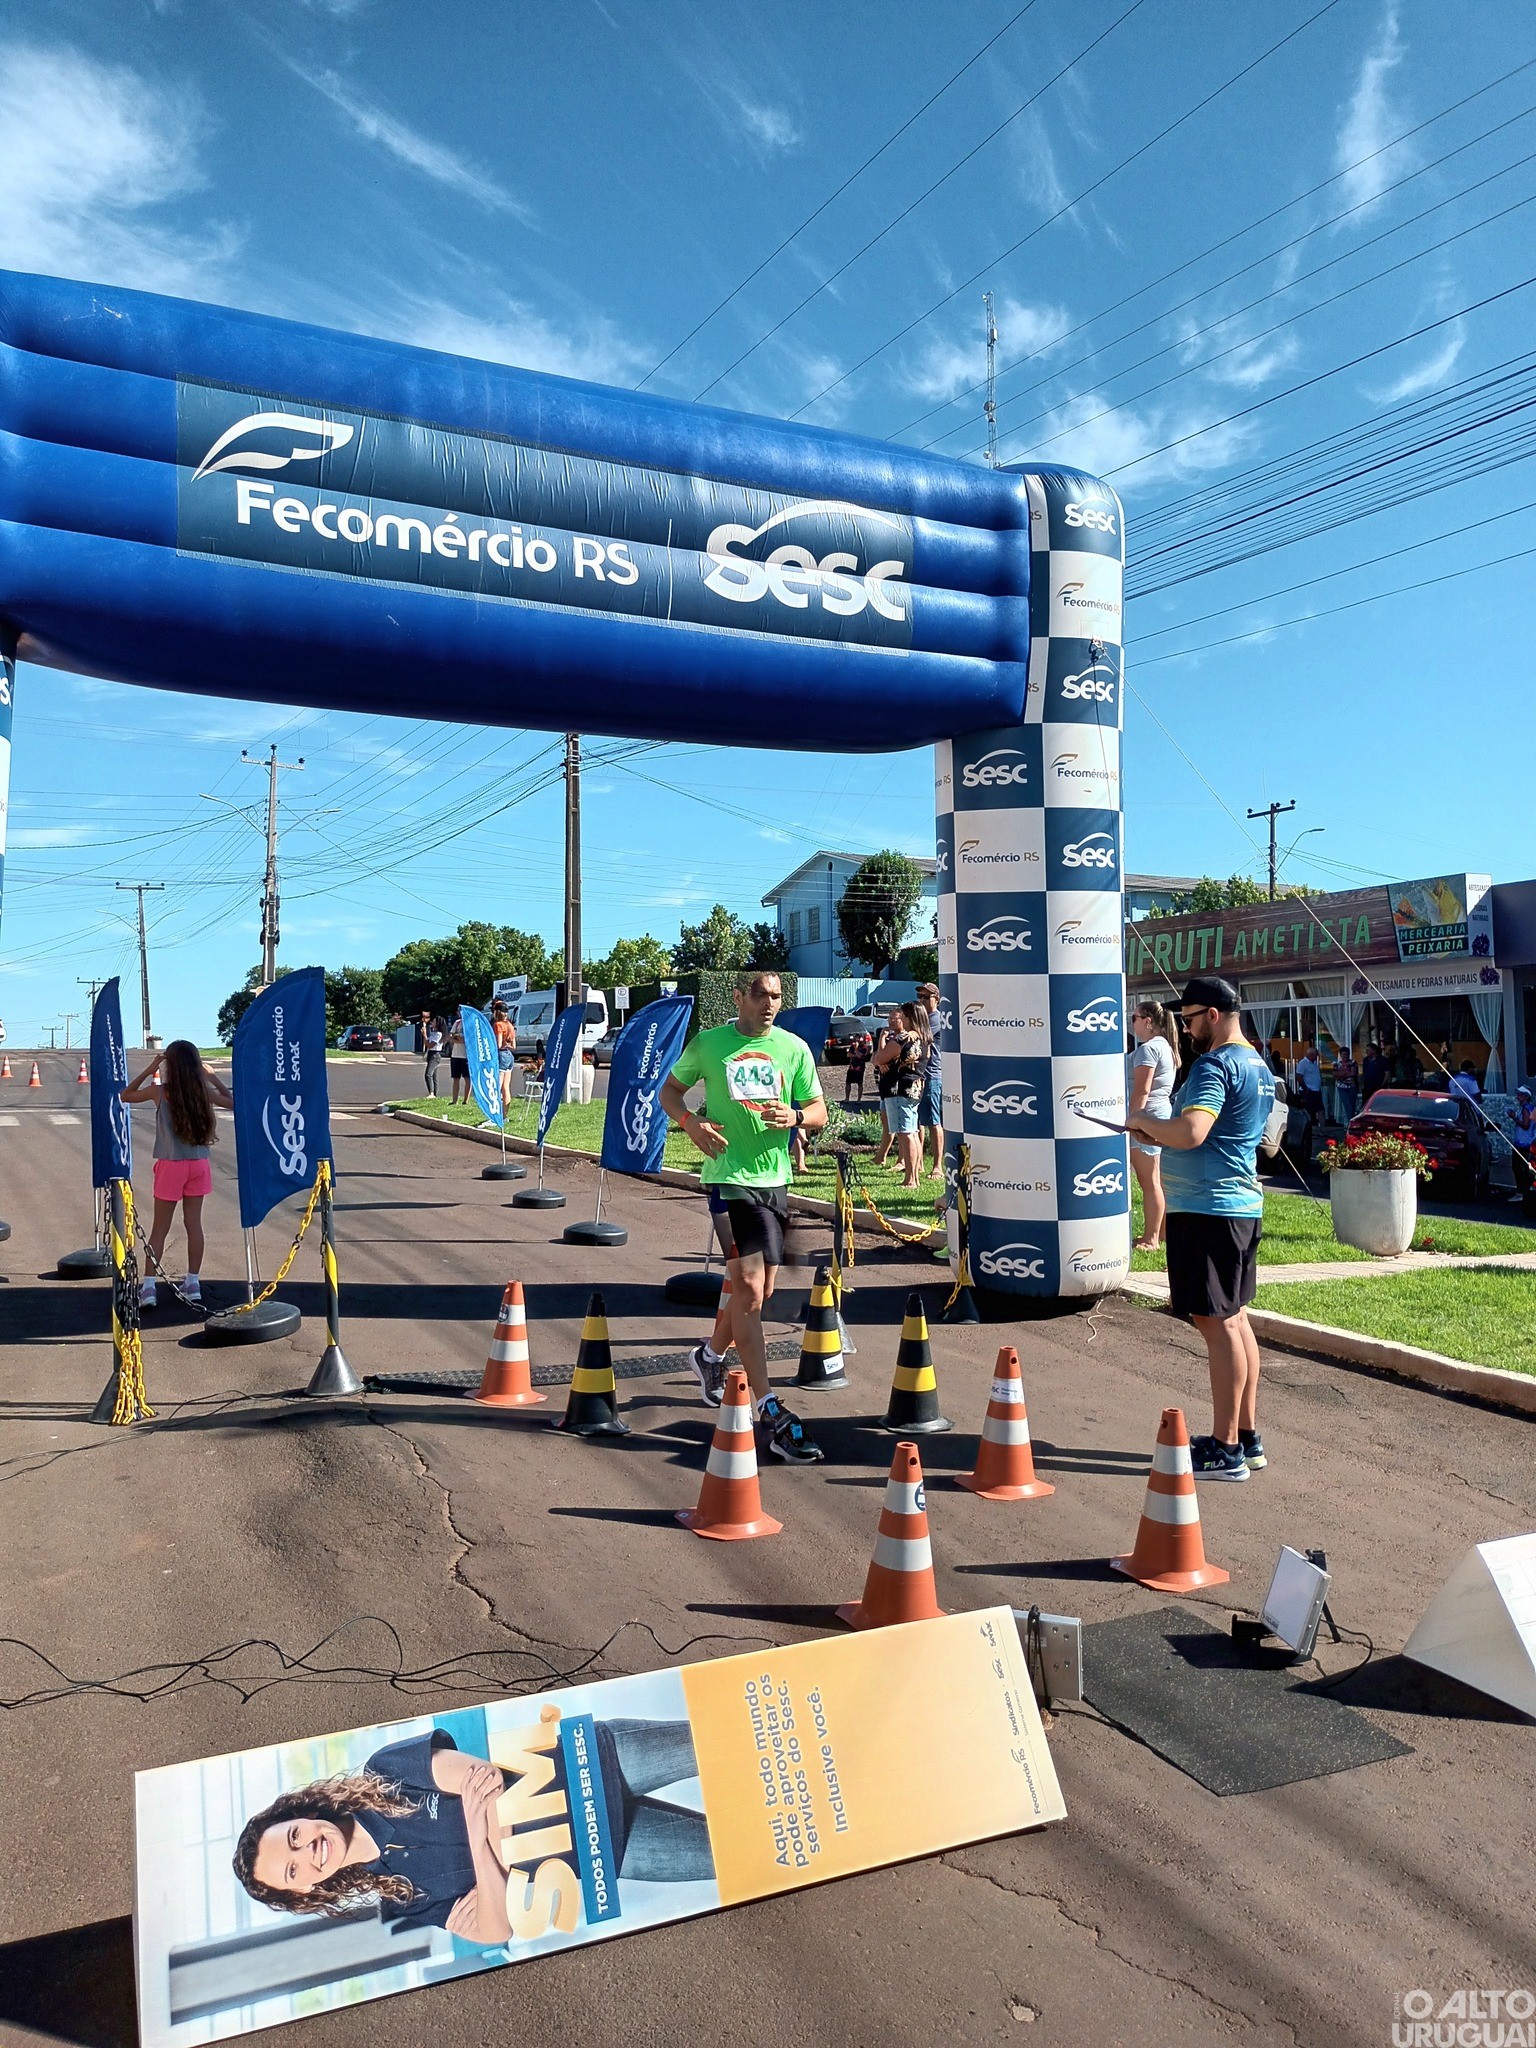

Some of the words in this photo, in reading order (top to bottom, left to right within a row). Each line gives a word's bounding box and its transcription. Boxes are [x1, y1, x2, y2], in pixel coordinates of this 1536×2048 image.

[236, 478, 558, 573] Fecomércio
[574, 534, 640, 586] RS
[1064, 495, 1116, 536] Sesc
[704, 499, 906, 621] Sesc
[1063, 596, 1113, 612] Fecomércio
[1113, 604, 1121, 615] RS
[1061, 665, 1115, 704] Sesc
[962, 748, 1028, 787] Sesc
[1057, 767, 1109, 779] Fecomércio
[1109, 770, 1118, 781] RS
[962, 852, 1021, 864] Fecomércio
[1023, 851, 1040, 862] RS
[1061, 832, 1115, 869] Sesc
[966, 915, 1032, 952] Sesc
[1061, 934, 1112, 945] Fecomércio
[1112, 934, 1120, 944] RS
[1125, 926, 1224, 976] IFRUTI
[1233, 914, 1371, 957] AMETISTA
[1400, 924, 1466, 940] MERCEARIA
[1408, 939, 1463, 954] PEIXARIA
[1371, 978, 1411, 990] ARTESANATO
[1412, 978, 1416, 988] E
[1417, 976, 1443, 988] PEDRAS
[1444, 973, 1478, 986] NATURAIS
[966, 1016, 1026, 1028] Fecomércio
[1028, 1017, 1045, 1028] RS
[1066, 996, 1119, 1033] Sesc
[272, 1005, 286, 1081] Fecomércio
[288, 1040, 301, 1081] Senac
[638, 1022, 658, 1079] Fecomércio
[650, 1049, 664, 1080] Senac
[734, 1065, 774, 1087] 443
[478, 1067, 500, 1115] Sesc
[971, 1079, 1038, 1115] Sesc
[1066, 1097, 1117, 1109] Fecomércio
[1117, 1096, 1125, 1105] RS
[262, 1094, 307, 1177] Sesc
[621, 1088, 656, 1154] Sesc
[972, 1176, 1032, 1191] Fecomércio
[1034, 1181, 1051, 1191] RS
[1072, 1158, 1124, 1197] Sesc
[979, 1243, 1045, 1279] Sesc
[1073, 1259, 1122, 1273] Fecomércio
[1203, 1459, 1226, 1470] FILA
[760, 1674, 773, 1697] os
[744, 1680, 768, 1751] mundo
[778, 1680, 795, 1732] Sesc.
[806, 1686, 828, 1739] você.
[1004, 1690, 1020, 1736] Sindicatos
[573, 1722, 588, 1766] SESC.
[765, 1703, 794, 1806] aproveitar
[788, 1736, 802, 1764] do
[1017, 1747, 1026, 1761] RS
[580, 1766, 593, 1797] SER
[759, 1756, 778, 1807] todo
[820, 1744, 849, 1833] Inclusive
[1022, 1762, 1041, 1814] Fecomércio
[426, 1792, 440, 1820] Sesc
[794, 1769, 821, 1854] serviços
[584, 1799, 603, 1856] PODEM
[768, 1811, 791, 1866] Aqui,
[786, 1812, 810, 1868] pode
[591, 1858, 609, 1914] TODOS
